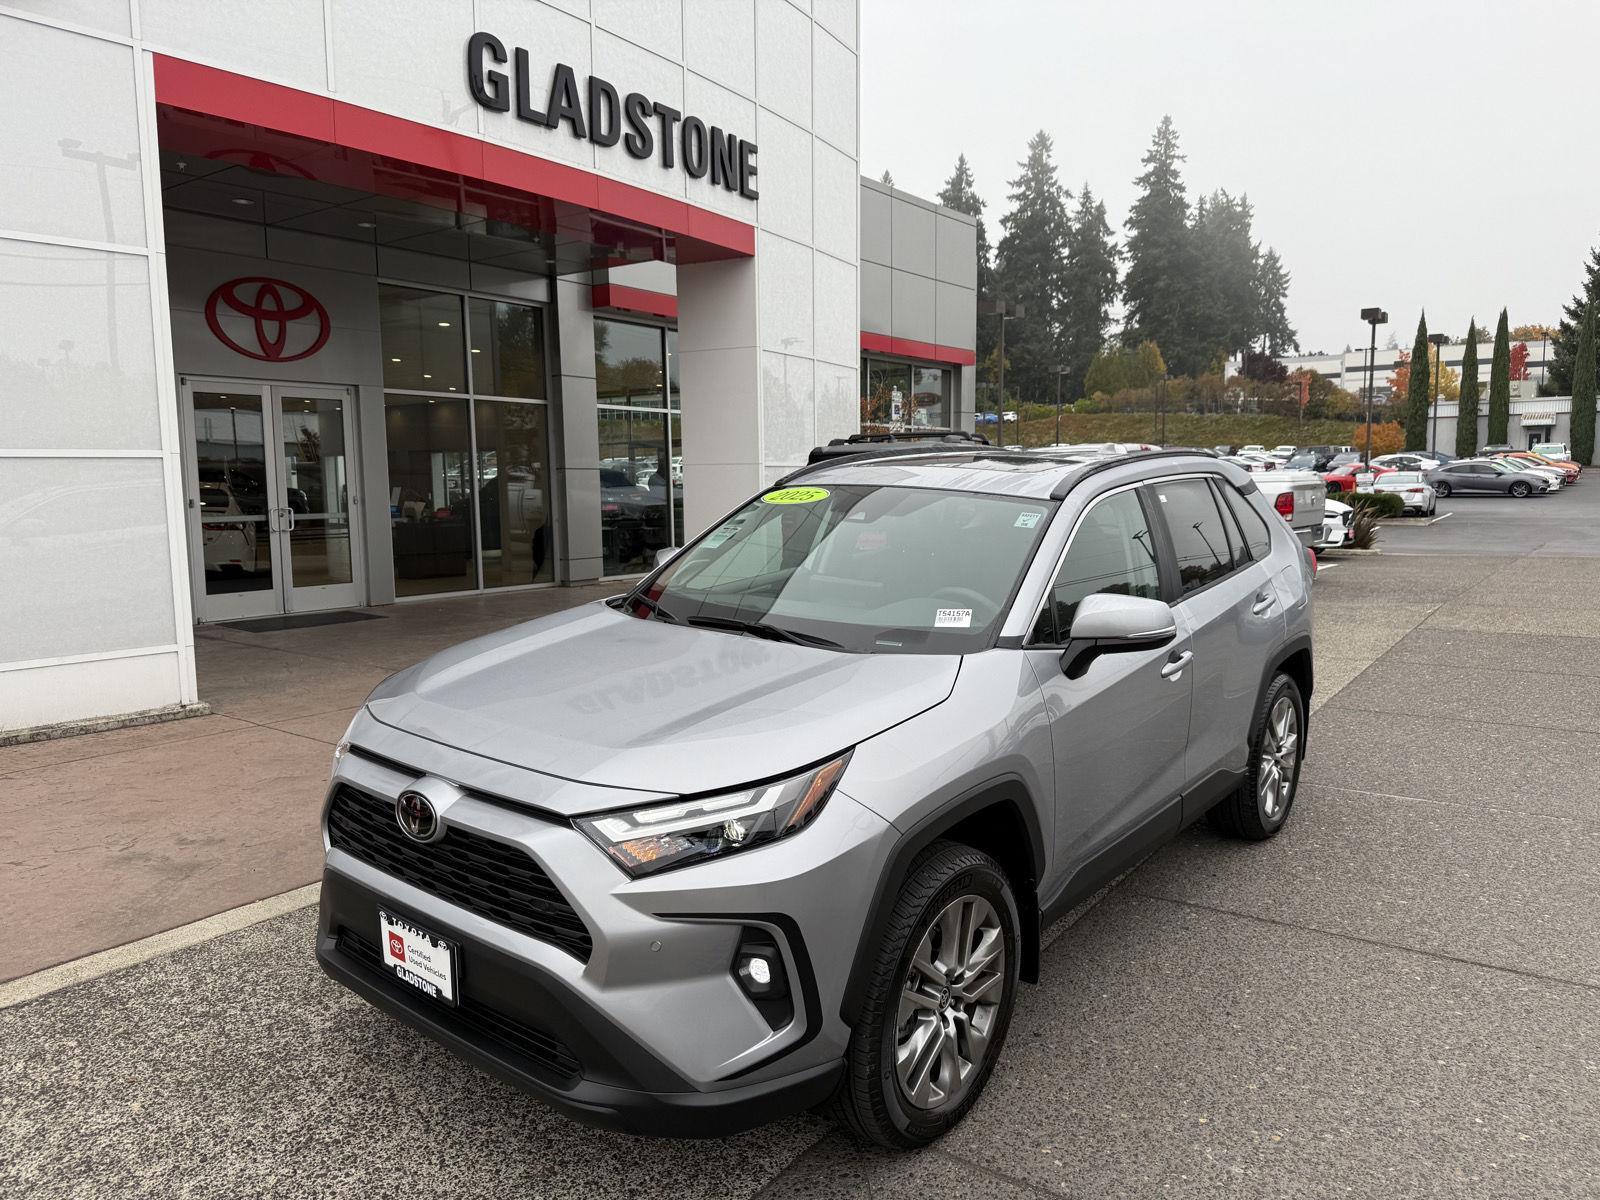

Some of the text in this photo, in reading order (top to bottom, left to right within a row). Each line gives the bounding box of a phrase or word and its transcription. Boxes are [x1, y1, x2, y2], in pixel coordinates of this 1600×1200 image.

[467, 31, 759, 201] GLADSTONE
[767, 490, 822, 502] 2025
[407, 944, 432, 963] Certified
[408, 955, 447, 981] Used Vehicles
[396, 965, 437, 999] GLADSTONE
